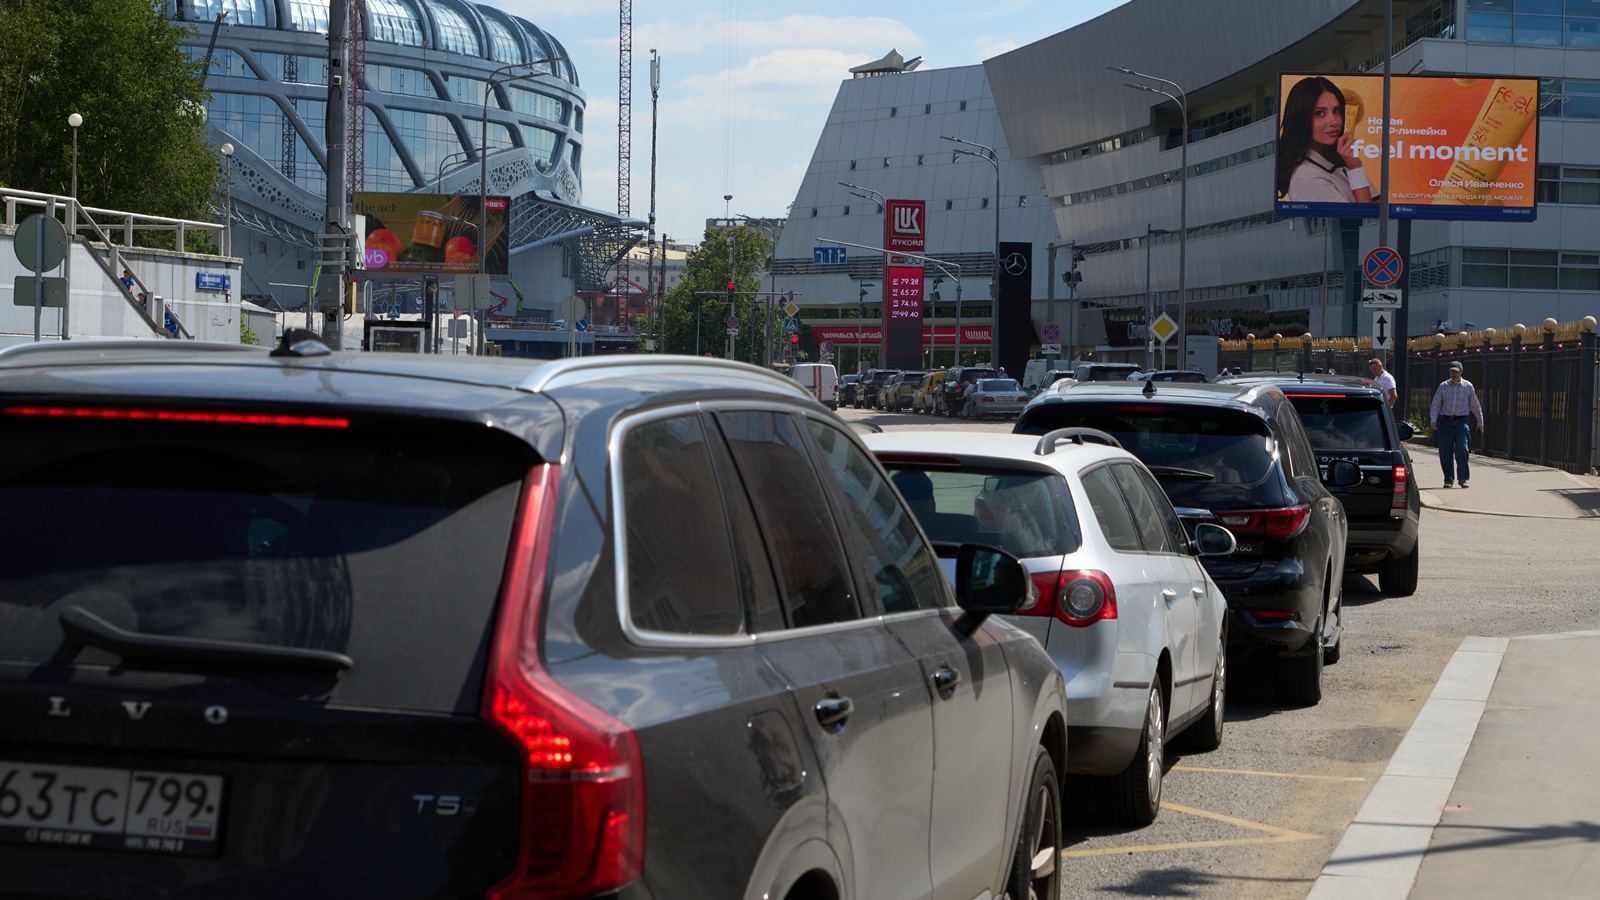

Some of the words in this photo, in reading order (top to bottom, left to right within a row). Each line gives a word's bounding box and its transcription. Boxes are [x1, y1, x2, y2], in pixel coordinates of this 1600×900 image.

[1368, 117, 1403, 125] Ноая
[1472, 131, 1487, 144] 50
[1350, 140, 1403, 159] feel
[1409, 144, 1528, 162] moment
[1429, 178, 1463, 188] Олеся
[1465, 179, 1525, 189] Иванченко
[356, 201, 375, 213] the
[377, 203, 398, 213] act
[891, 239, 924, 247] ЛУКОЙЛ
[900, 278, 919, 286] 79.28
[900, 288, 919, 296] 65.27
[900, 299, 919, 307] 74.16
[899, 310, 919, 318] 99.40
[134, 775, 208, 819] 799
[412, 794, 461, 815] T5
[147, 817, 184, 834] RUS
